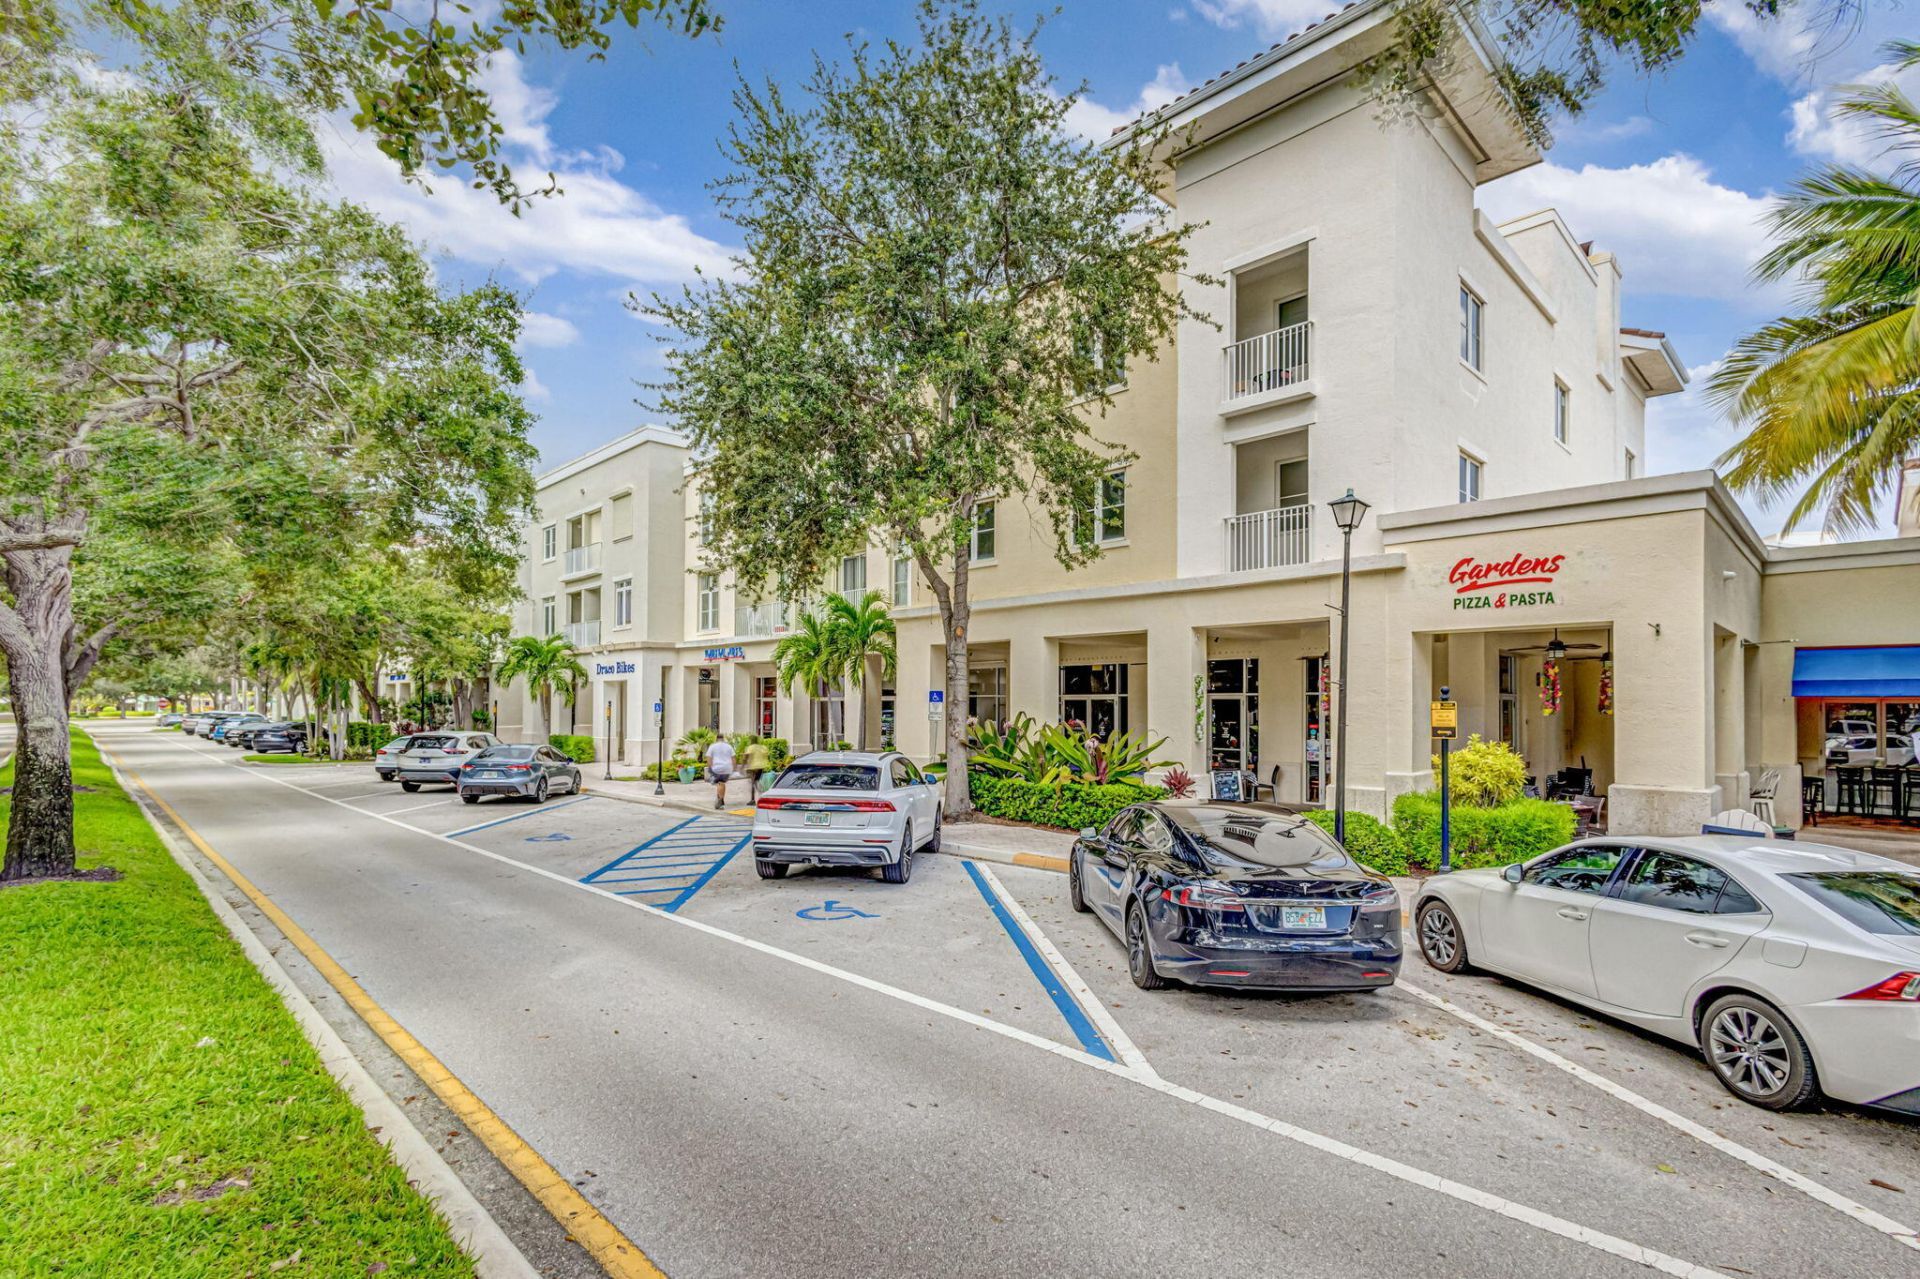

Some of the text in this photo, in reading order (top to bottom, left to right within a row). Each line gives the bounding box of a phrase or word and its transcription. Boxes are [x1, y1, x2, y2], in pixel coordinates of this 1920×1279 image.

[1449, 553, 1566, 584] Gardens
[1453, 592, 1555, 610] PIZZA & PASTA
[596, 661, 636, 675] Draco Bikes
